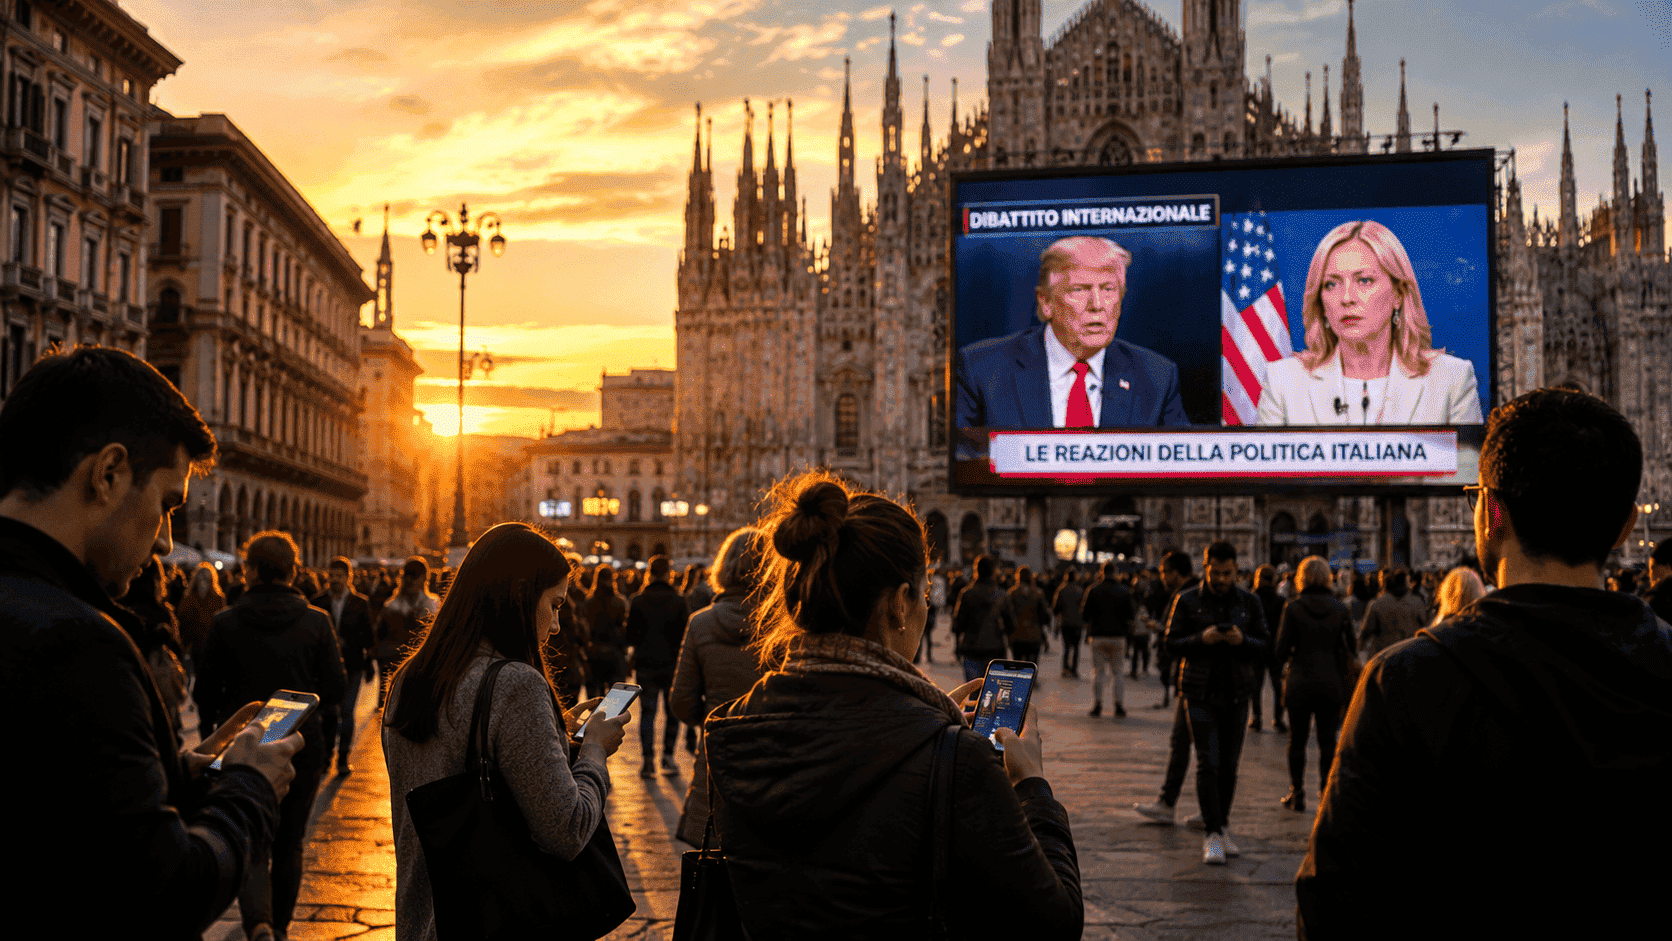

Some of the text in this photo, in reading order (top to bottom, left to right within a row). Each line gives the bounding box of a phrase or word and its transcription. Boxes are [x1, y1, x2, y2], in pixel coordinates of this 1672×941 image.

[970, 204, 1211, 229] DIBATTITO INTERNAZIONALE
[1025, 443, 1428, 462] LE REAZIONI DELLA POLITICA ITALIANA
